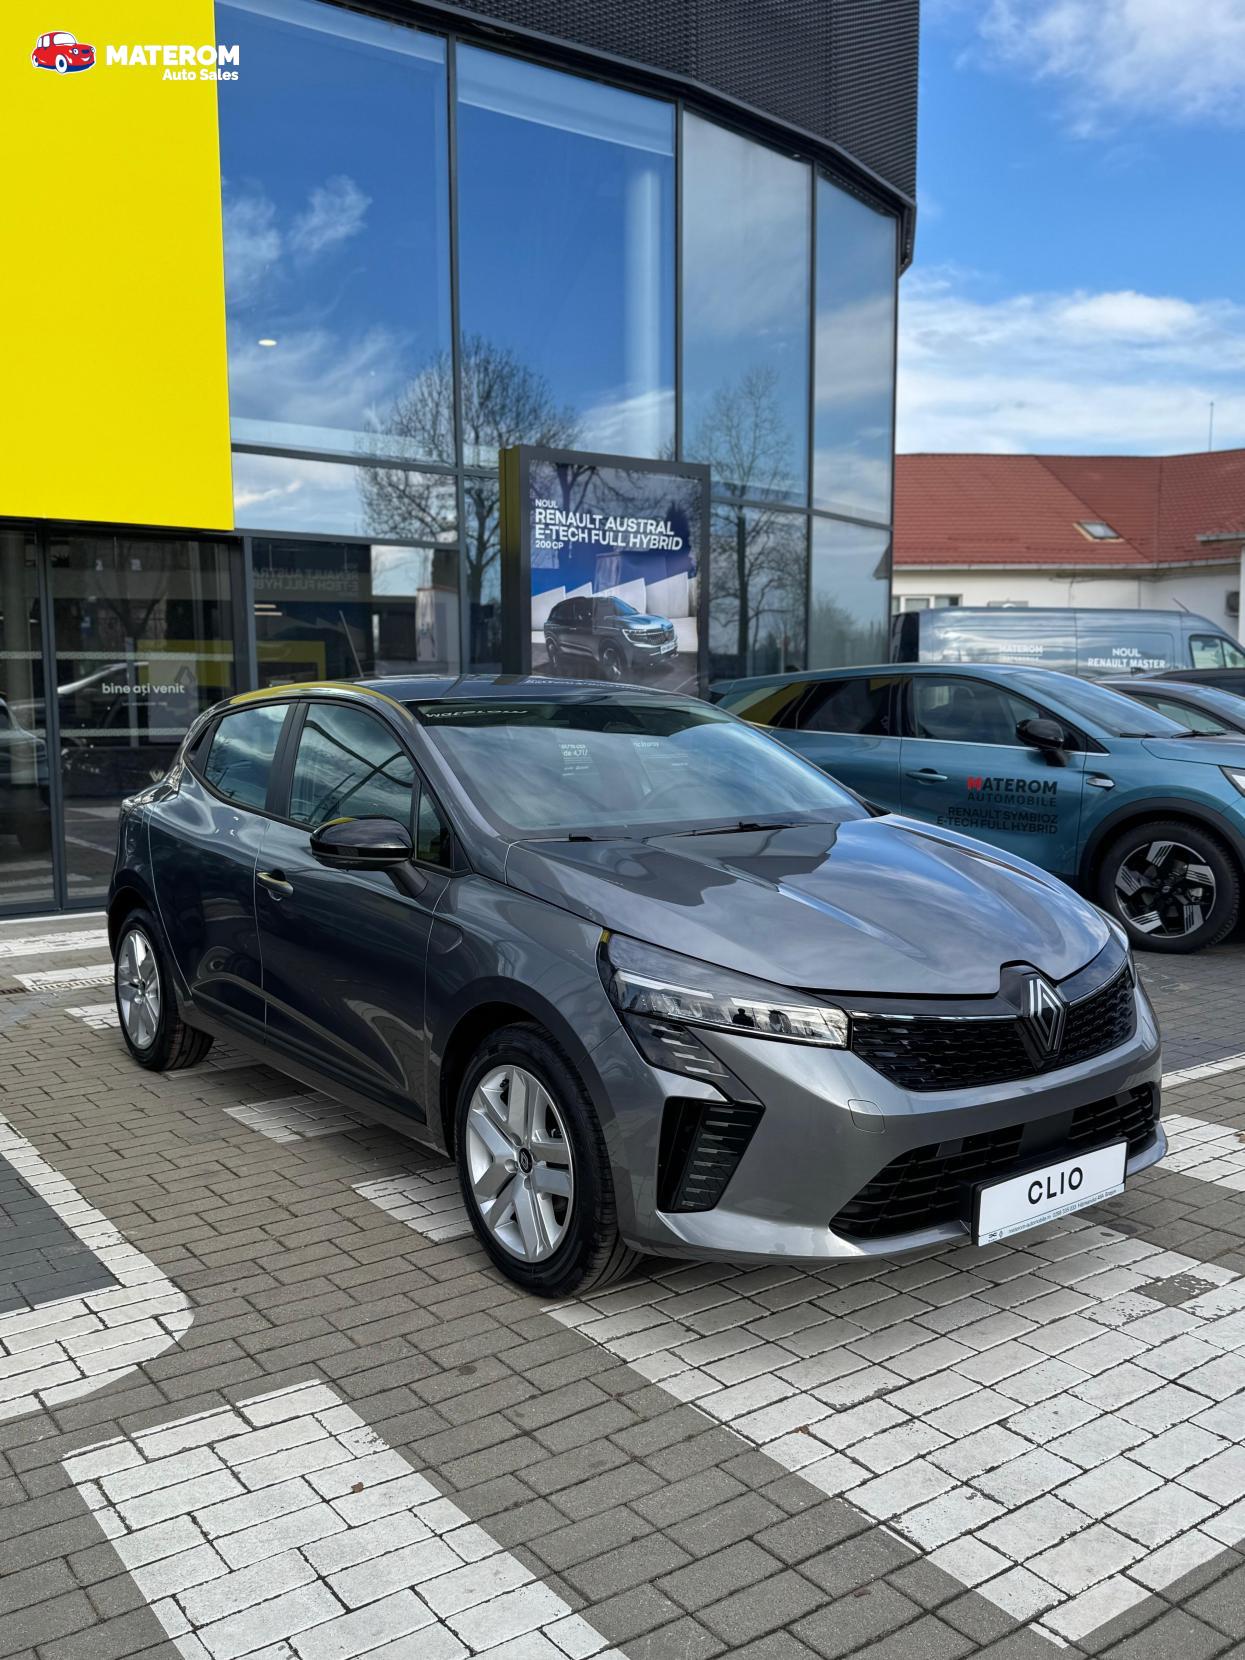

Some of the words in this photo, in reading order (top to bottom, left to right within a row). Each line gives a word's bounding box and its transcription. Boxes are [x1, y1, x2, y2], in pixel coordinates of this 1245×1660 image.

[535, 499, 558, 509] NOUL
[535, 508, 603, 529] RENAULT
[604, 516, 675, 535] AUSTRAL
[535, 524, 589, 543] E-TECH
[591, 530, 626, 547] FULL
[628, 534, 683, 551] HYBRID
[1112, 647, 1141, 657] NOUL
[1087, 657, 1128, 668] RENAULT
[1129, 659, 1166, 669] MASTER
[102, 683, 131, 694] bine
[153, 683, 185, 694] venit
[967, 776, 1058, 795] MATEROM
[967, 791, 1057, 807] AUTOMOBILE
[948, 806, 1001, 819] RENAULT
[1002, 809, 1058, 824] SYMBIOZ
[936, 815, 979, 828] E-TECH
[980, 818, 1009, 831] FULL
[1010, 821, 1058, 834] HYBRID
[1028, 1166, 1084, 1205] CLIO
